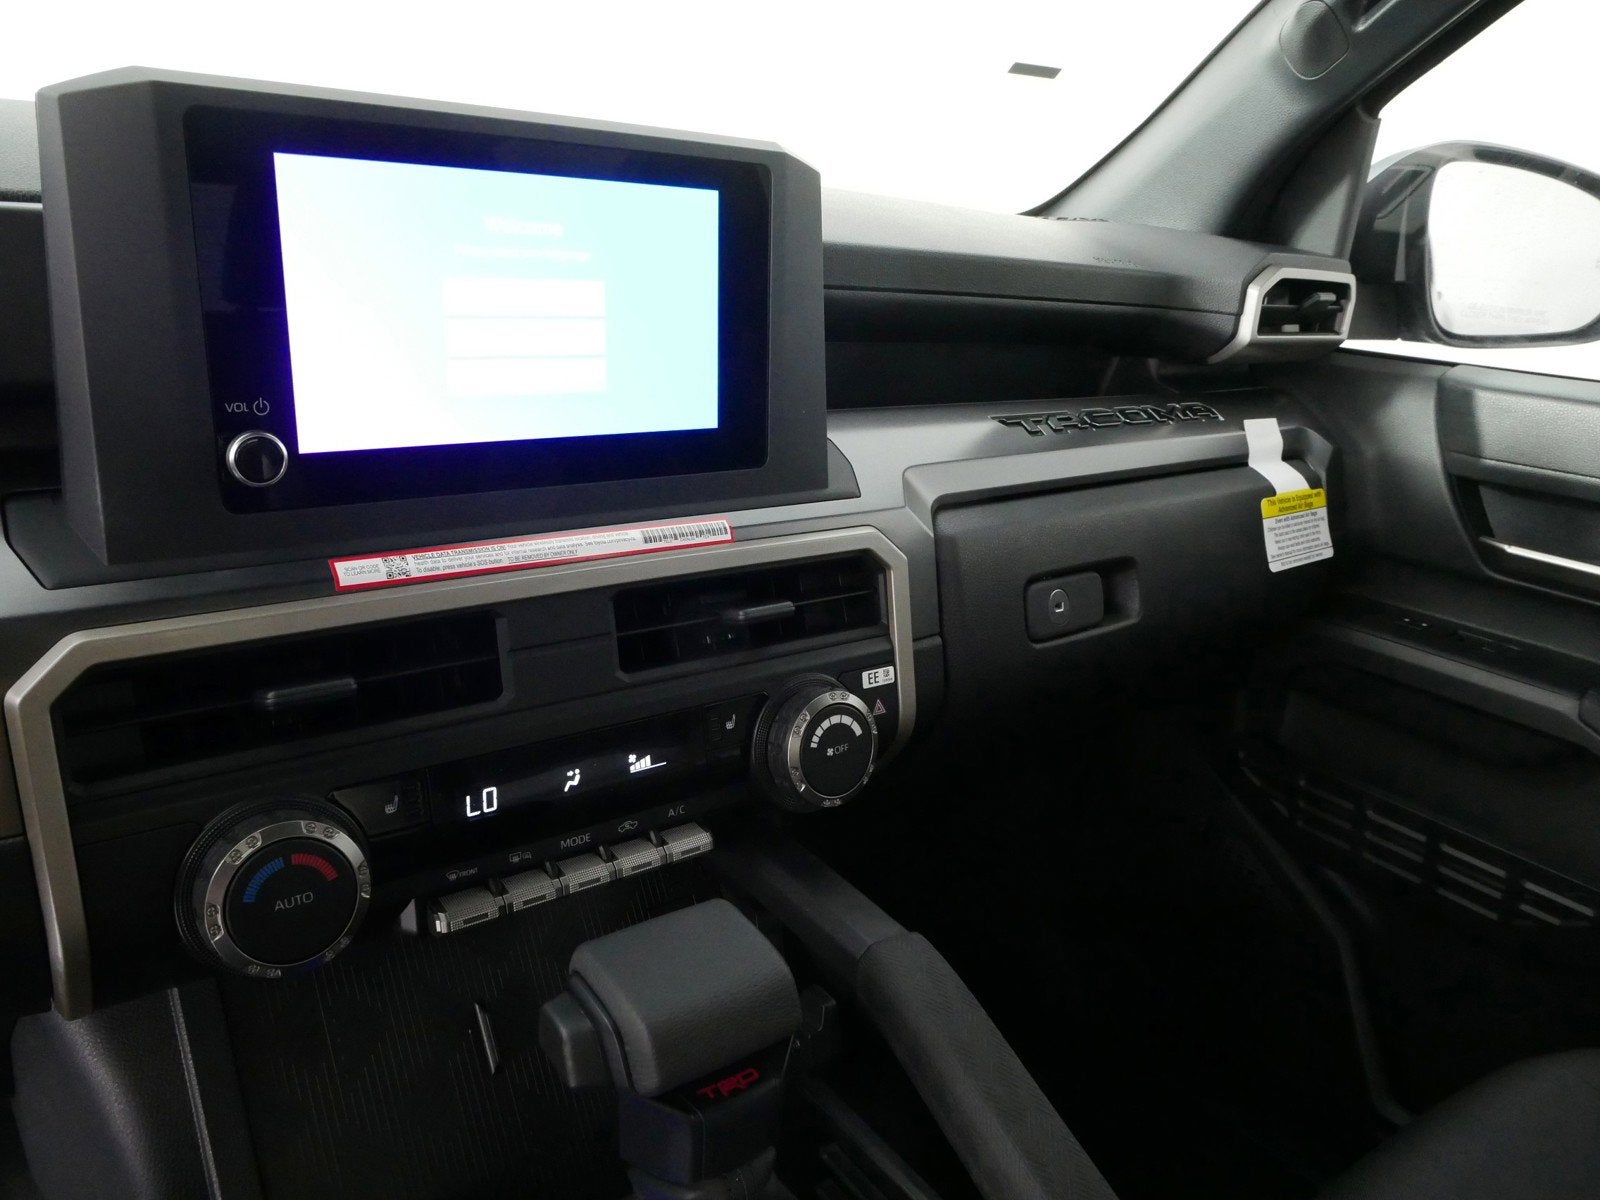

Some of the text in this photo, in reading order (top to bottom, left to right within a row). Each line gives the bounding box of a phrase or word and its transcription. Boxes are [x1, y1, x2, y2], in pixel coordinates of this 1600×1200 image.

[225, 402, 249, 413] VOL
[987, 402, 1225, 437] TACOMA
[450, 546, 490, 557] TRANSMISSION
[521, 553, 543, 561] REMOVED
[867, 672, 880, 685] EE
[834, 743, 849, 755] OFF
[667, 803, 687, 819] A/C
[560, 832, 592, 850] MODE
[274, 891, 315, 913] AUTO
[695, 1067, 761, 1099] TRD
